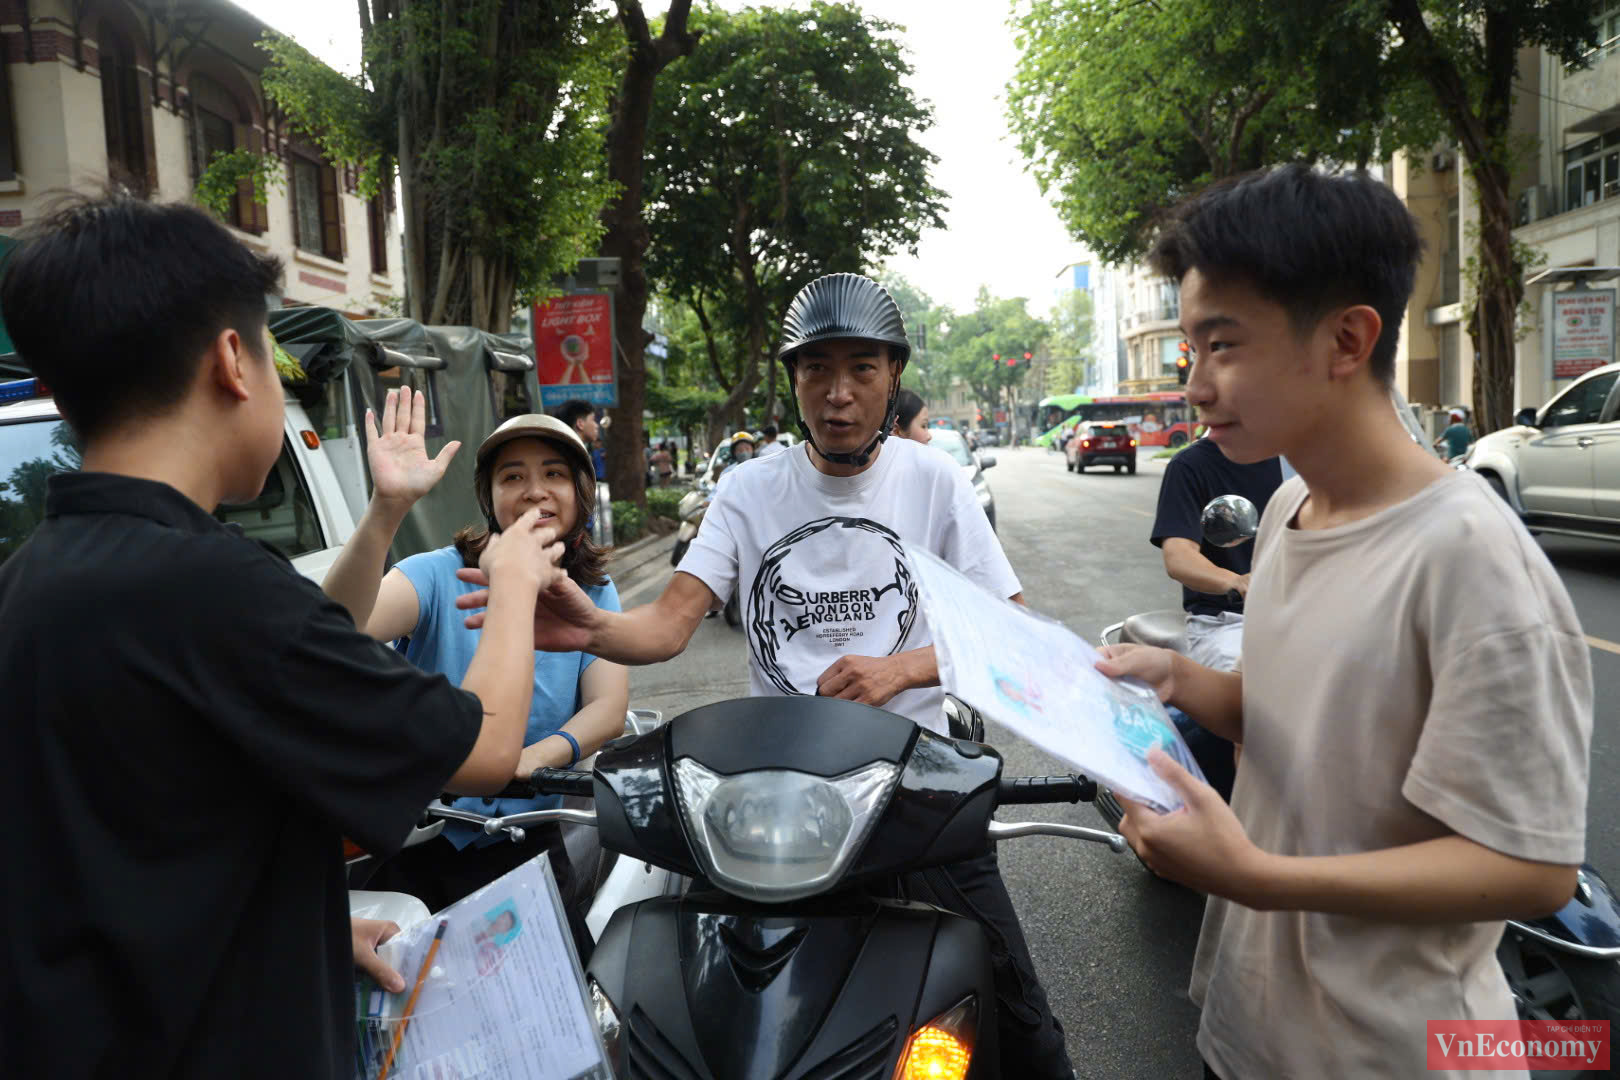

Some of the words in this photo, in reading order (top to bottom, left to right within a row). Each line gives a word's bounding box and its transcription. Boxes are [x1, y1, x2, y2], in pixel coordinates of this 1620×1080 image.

[541, 315, 577, 329] LIGHT
[577, 312, 603, 325] BOX
[805, 602, 873, 616] LONDON
